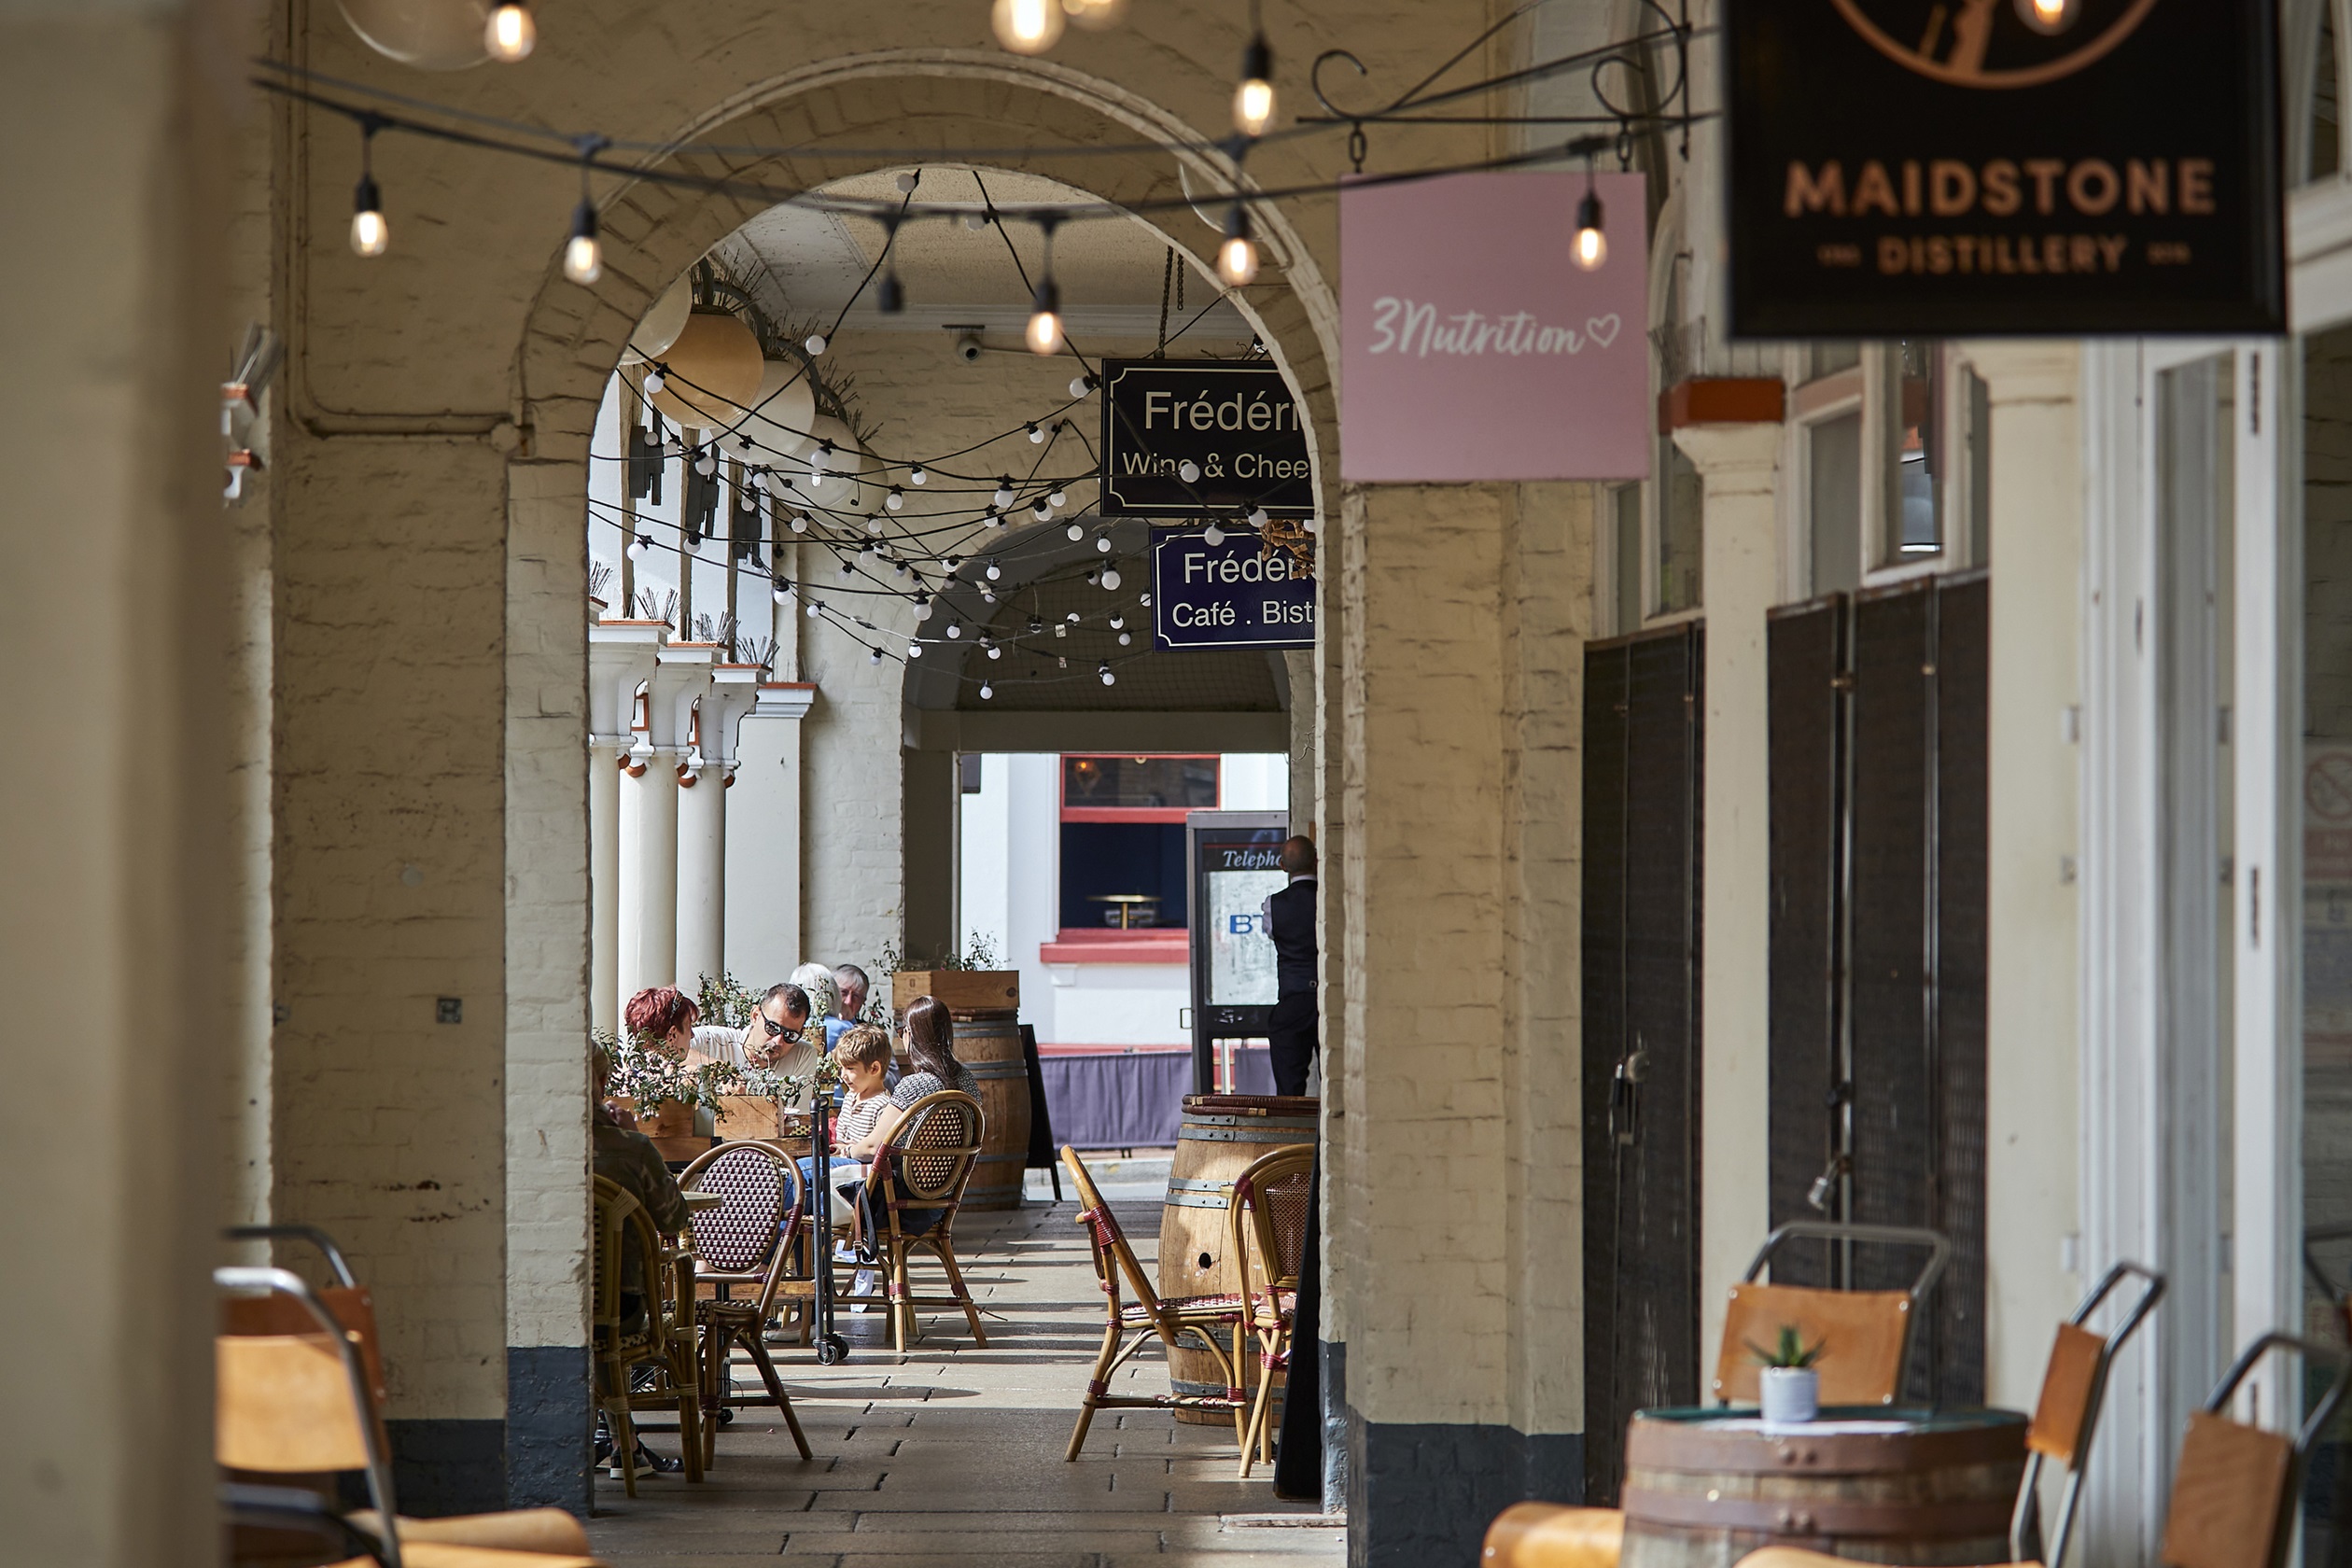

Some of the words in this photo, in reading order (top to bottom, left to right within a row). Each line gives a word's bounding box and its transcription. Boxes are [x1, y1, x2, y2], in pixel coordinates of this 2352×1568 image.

[1783, 158, 2217, 217] MAIDSTONE
[1877, 235, 2127, 273] DISTILLERY
[1368, 296, 1585, 357] 3Nutrition
[1204, 453, 1225, 478] &
[1172, 601, 1236, 627] Café
